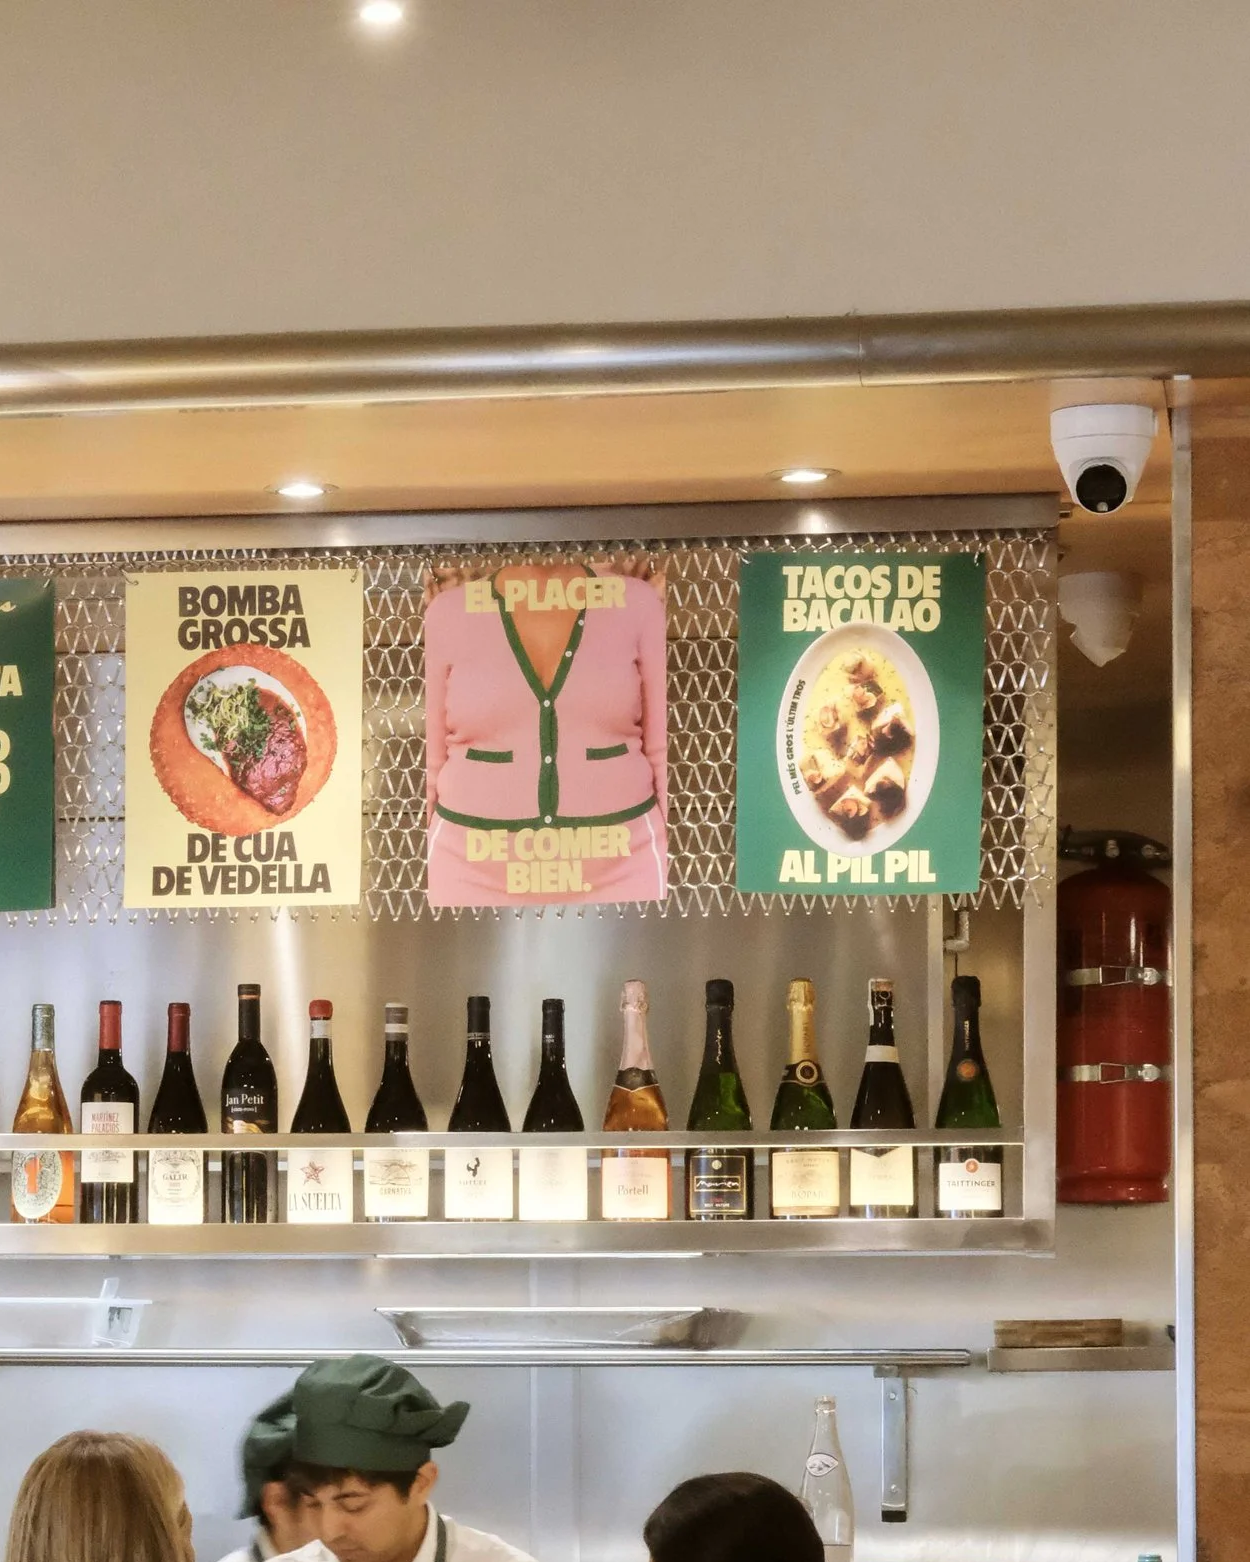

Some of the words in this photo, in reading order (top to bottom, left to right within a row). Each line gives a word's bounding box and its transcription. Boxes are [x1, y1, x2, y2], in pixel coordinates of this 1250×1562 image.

[465, 580, 500, 613] EL
[503, 576, 627, 613] PLACER
[782, 564, 892, 600] TACOS
[897, 565, 942, 599] DE
[177, 584, 305, 618] BOMBA
[782, 598, 942, 633] BACALAO
[177, 616, 312, 651] GROSSA
[785, 734, 795, 761] GROS
[792, 678, 806, 702] TROS
[186, 832, 227, 864] DE
[233, 831, 298, 864] CUA
[466, 828, 509, 862] DE
[514, 824, 632, 861] COMER
[151, 865, 192, 897] DE
[198, 862, 332, 896] VEDELLA
[506, 860, 593, 894] BIEN.
[779, 849, 822, 884] AL
[827, 850, 880, 884] PIL
[884, 849, 937, 884] PIL
[225, 1094, 240, 1107] Jan
[241, 1093, 264, 1105] Petit
[617, 1184, 649, 1197] Portell
[946, 1179, 996, 1188] TAITTINGER
[301, 1191, 343, 1212] SUELTA
